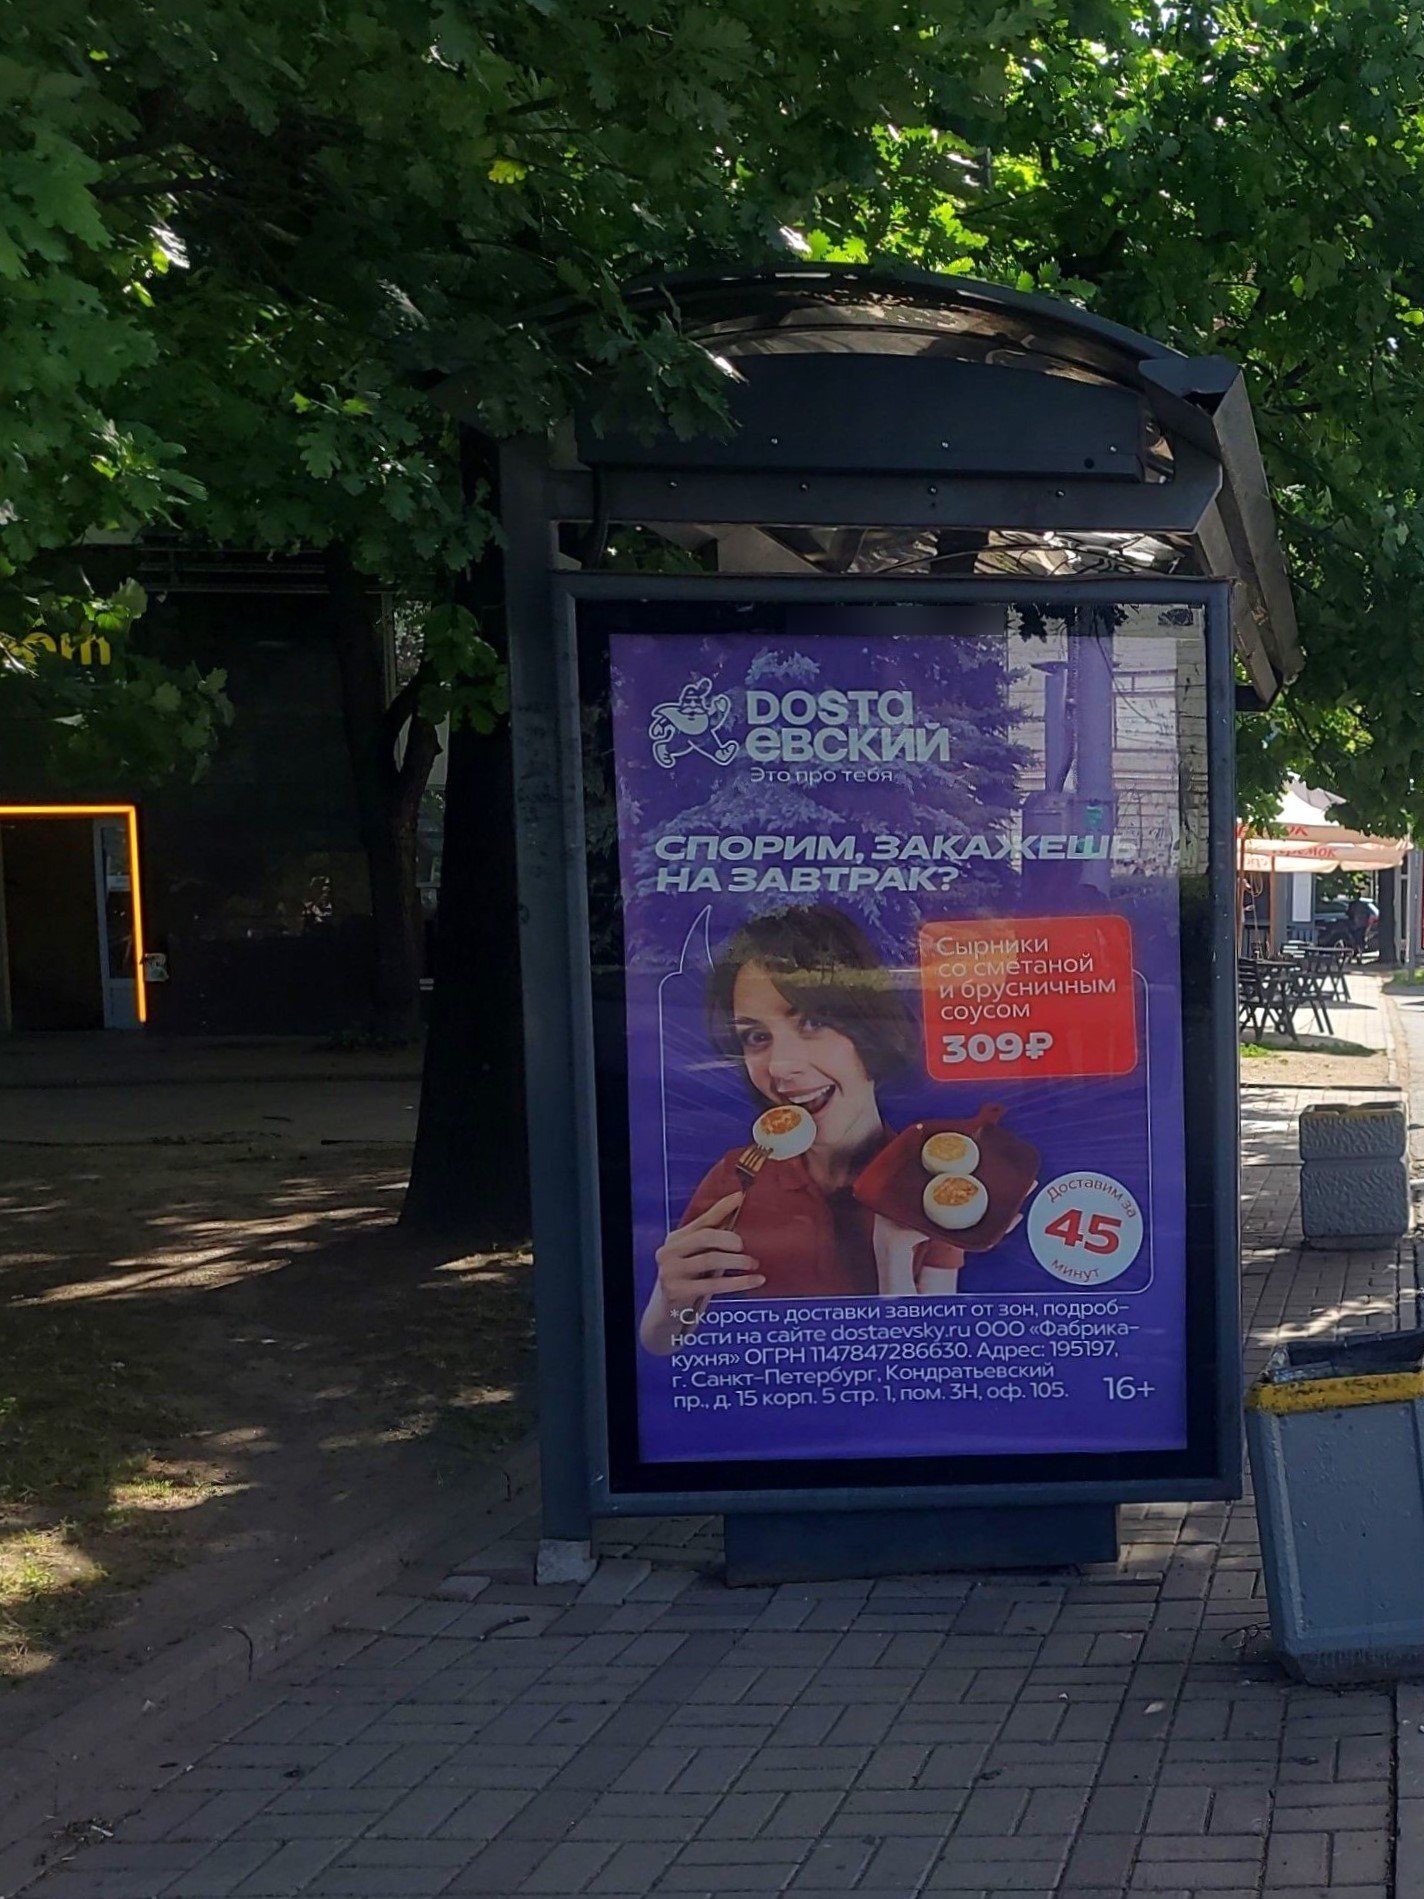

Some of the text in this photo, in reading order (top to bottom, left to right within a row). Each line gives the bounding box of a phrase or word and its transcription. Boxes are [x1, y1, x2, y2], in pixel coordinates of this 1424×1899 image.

[751, 768, 893, 785] Это про тебя
[655, 834, 1137, 863] СПОРИМ, ЗАКАЖЕШЬ
[656, 866, 960, 892] НА ЗАВТРАК?
[937, 937, 1049, 959] Сырники
[939, 953, 1094, 978] со сметаной
[939, 978, 1116, 1002] и брусничным
[941, 1003, 1030, 1024] соусом
[942, 1031, 1053, 1063] 309₽
[1047, 1179, 1137, 1218] Доставим за
[1044, 1208, 1122, 1255] 45
[1051, 1259, 1100, 1282] минут
[783, 1306, 880, 1324] доставки
[885, 1303, 967, 1319] зависит
[971, 1304, 994, 1317] от
[998, 1303, 1039, 1318] зон,
[671, 1331, 732, 1346] ности
[737, 1330, 761, 1344] на
[767, 1325, 826, 1343] сайте
[831, 1322, 970, 1342] dostaevsky.ru
[975, 1320, 1025, 1337] ООО
[671, 1340, 1119, 1371] кухня» ОГРН 1147847286630. Адрес: 195197,
[672, 1375, 687, 1388] г.
[886, 1362, 1054, 1383] Кондратьевский
[1102, 1376, 1155, 1400] 16+
[674, 1395, 709, 1411] пр.,
[713, 1395, 731, 1409] д.
[736, 1390, 758, 1406] 15
[762, 1391, 817, 1408] корп.
[822, 1387, 836, 1404] 5
[840, 1389, 879, 1406] стр.
[884, 1385, 896, 1403] 1,
[900, 1387, 945, 1401] пом.
[986, 1382, 1026, 1402] оф.
[1030, 1382, 1069, 1399] 105.
